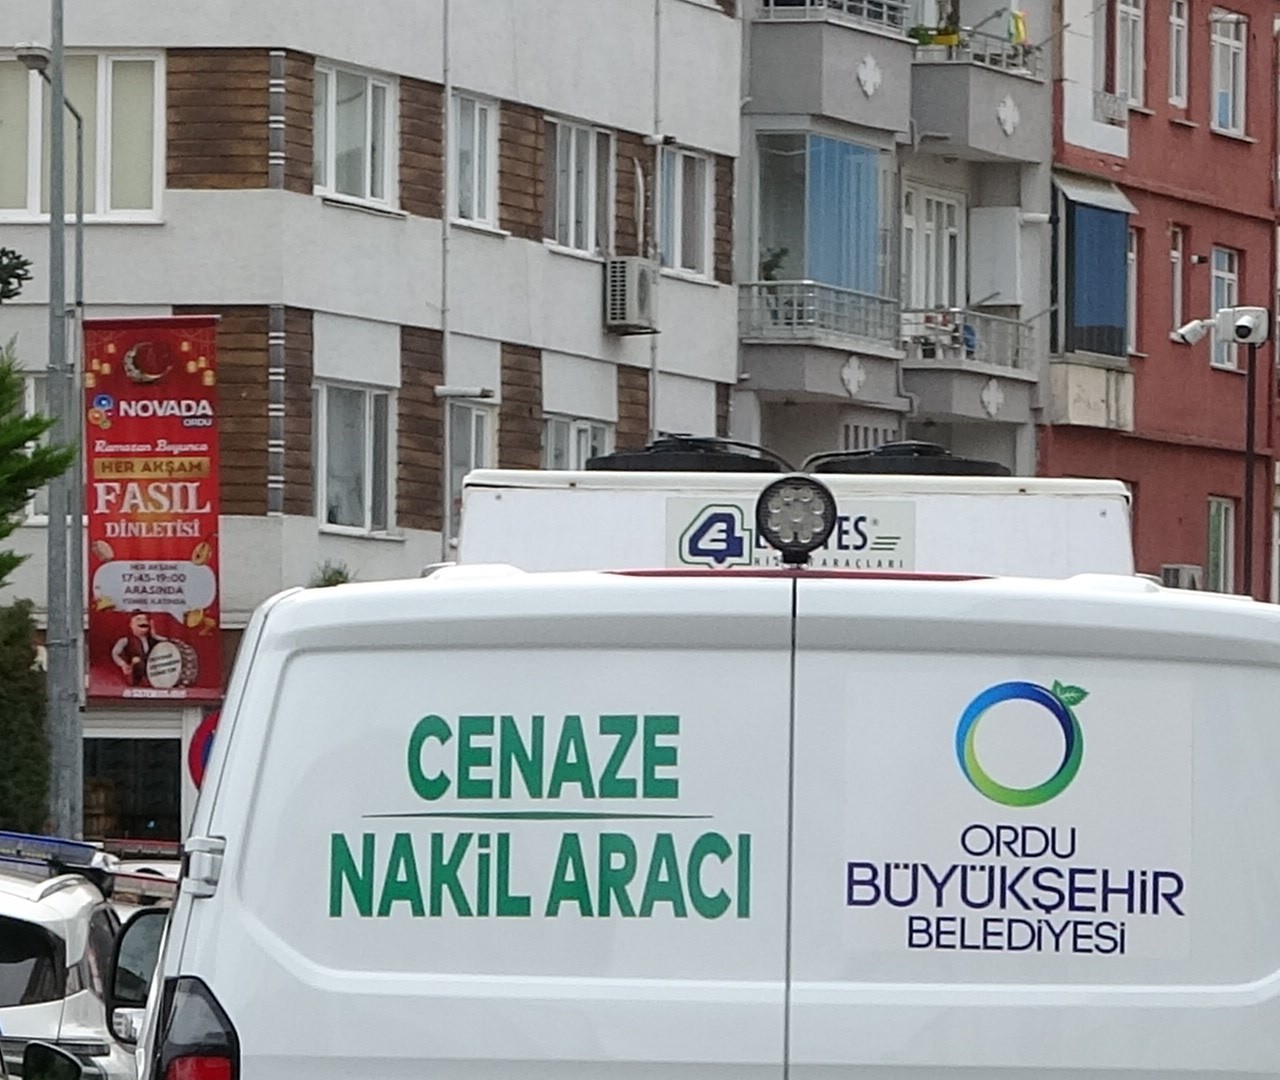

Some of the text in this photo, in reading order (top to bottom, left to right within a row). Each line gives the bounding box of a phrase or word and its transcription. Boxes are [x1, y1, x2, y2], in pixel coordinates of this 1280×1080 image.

[119, 400, 213, 416] NOVADA
[101, 461, 202, 476] HER AKŞAM
[93, 482, 211, 514] FASIL
[105, 519, 200, 537] DİNLETİSİ
[124, 585, 184, 595] ARASINDA
[407, 714, 680, 801] CENAZE
[960, 824, 1077, 859] ORDU
[543, 831, 752, 920] ARACI
[846, 861, 1186, 916] BÜYÜKŞEHİR
[907, 914, 1127, 956] BELEDİYESİ
